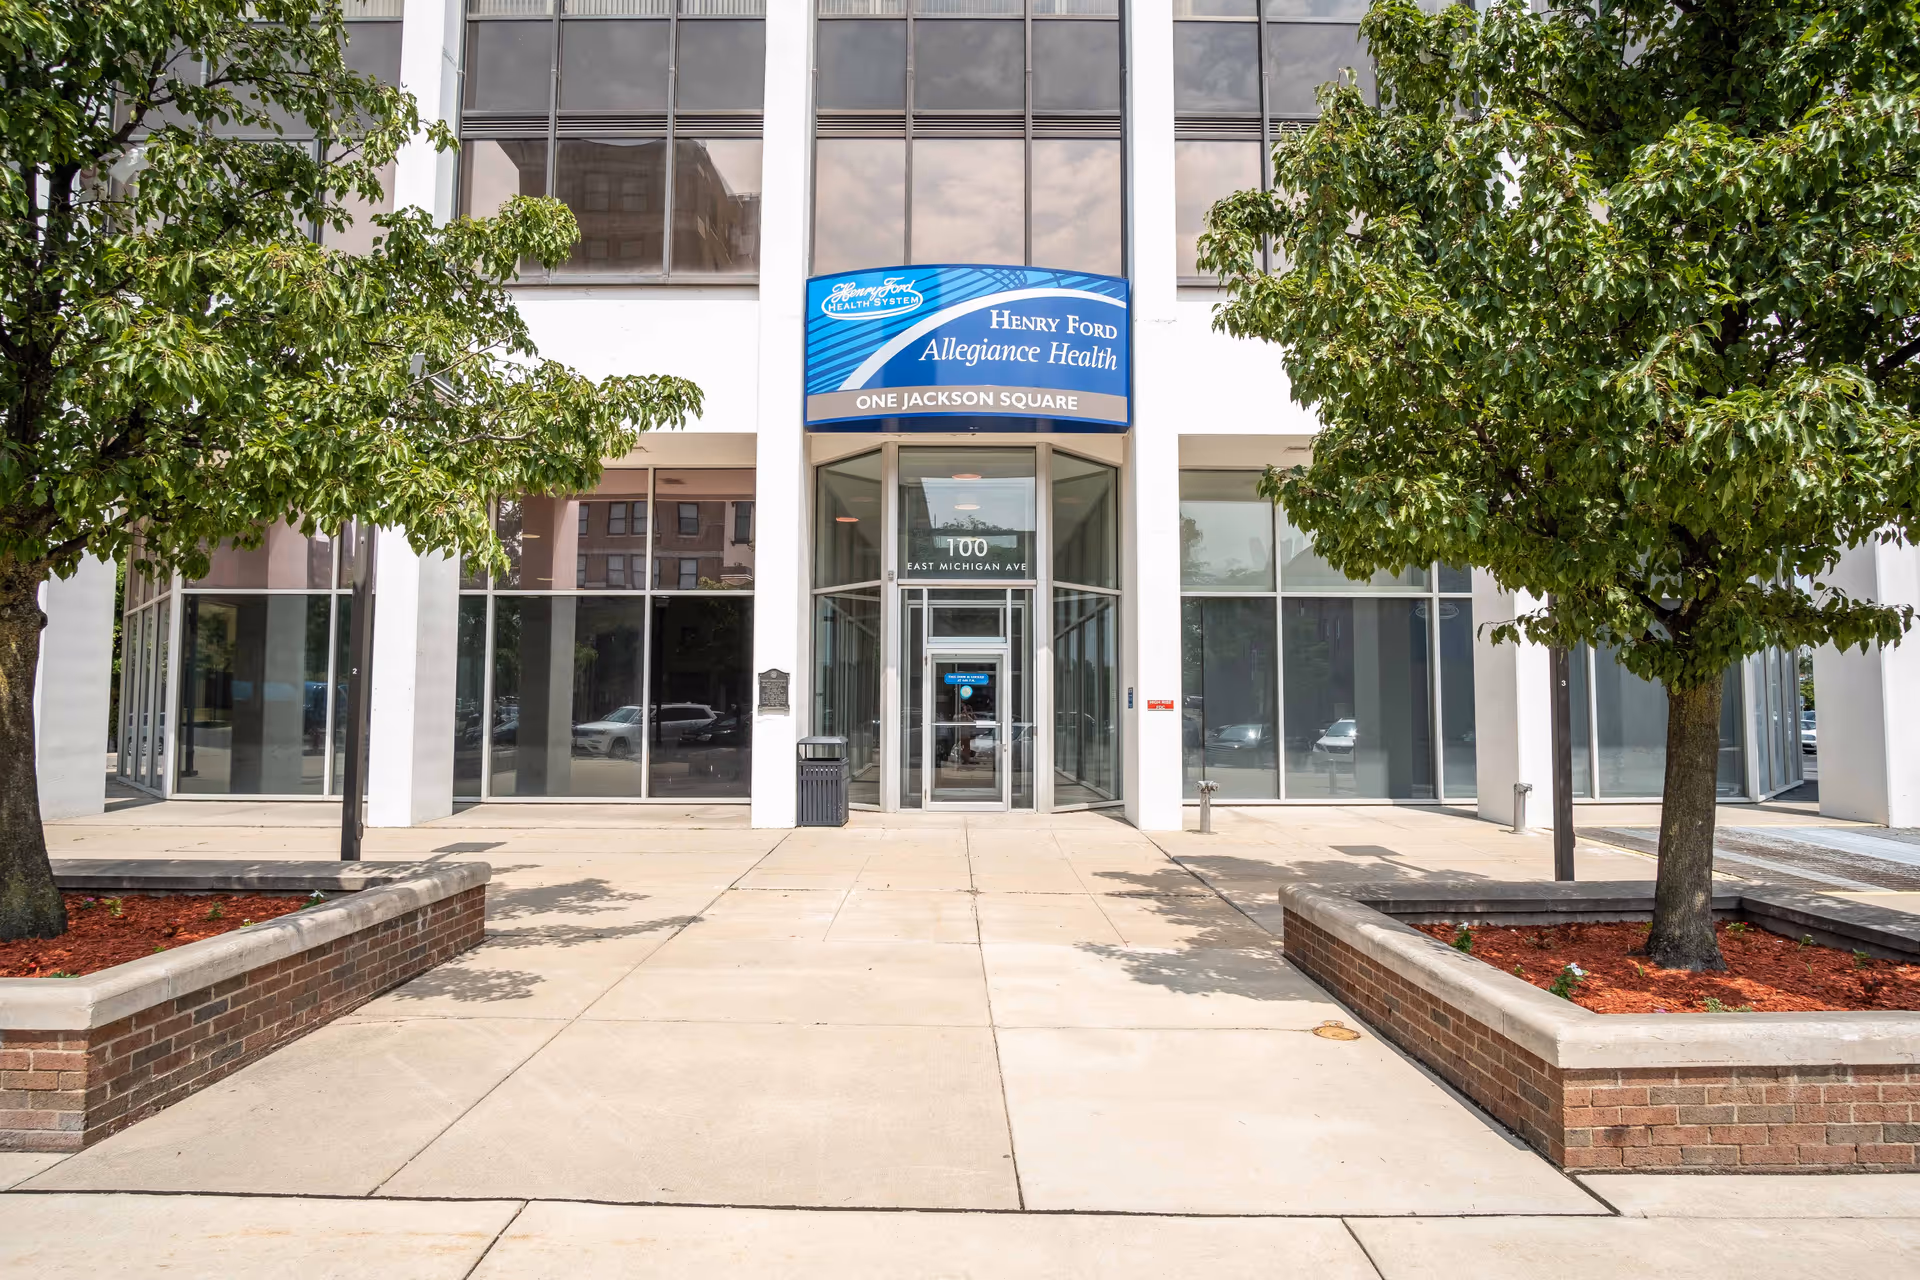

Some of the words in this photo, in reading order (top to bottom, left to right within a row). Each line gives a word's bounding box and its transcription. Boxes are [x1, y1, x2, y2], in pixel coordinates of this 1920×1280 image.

[831, 282, 879, 303] Henry
[878, 276, 916, 298] Ford
[828, 301, 870, 312] HEALTH
[874, 297, 919, 306] SYSTEM
[990, 309, 1060, 333] HENRY
[1066, 314, 1118, 340] FORD
[918, 337, 1041, 367] Allegiance
[1047, 341, 1118, 371] Health
[856, 393, 898, 410] ONE
[901, 391, 994, 411] JACKSON
[999, 392, 1078, 411] SQUARE
[946, 538, 988, 557] 100
[907, 562, 935, 571] EAST
[939, 562, 1000, 571] MICHIGAN
[1005, 562, 1027, 571] AVE
[352, 667, 358, 675] 2
[1561, 679, 1567, 687] 3
